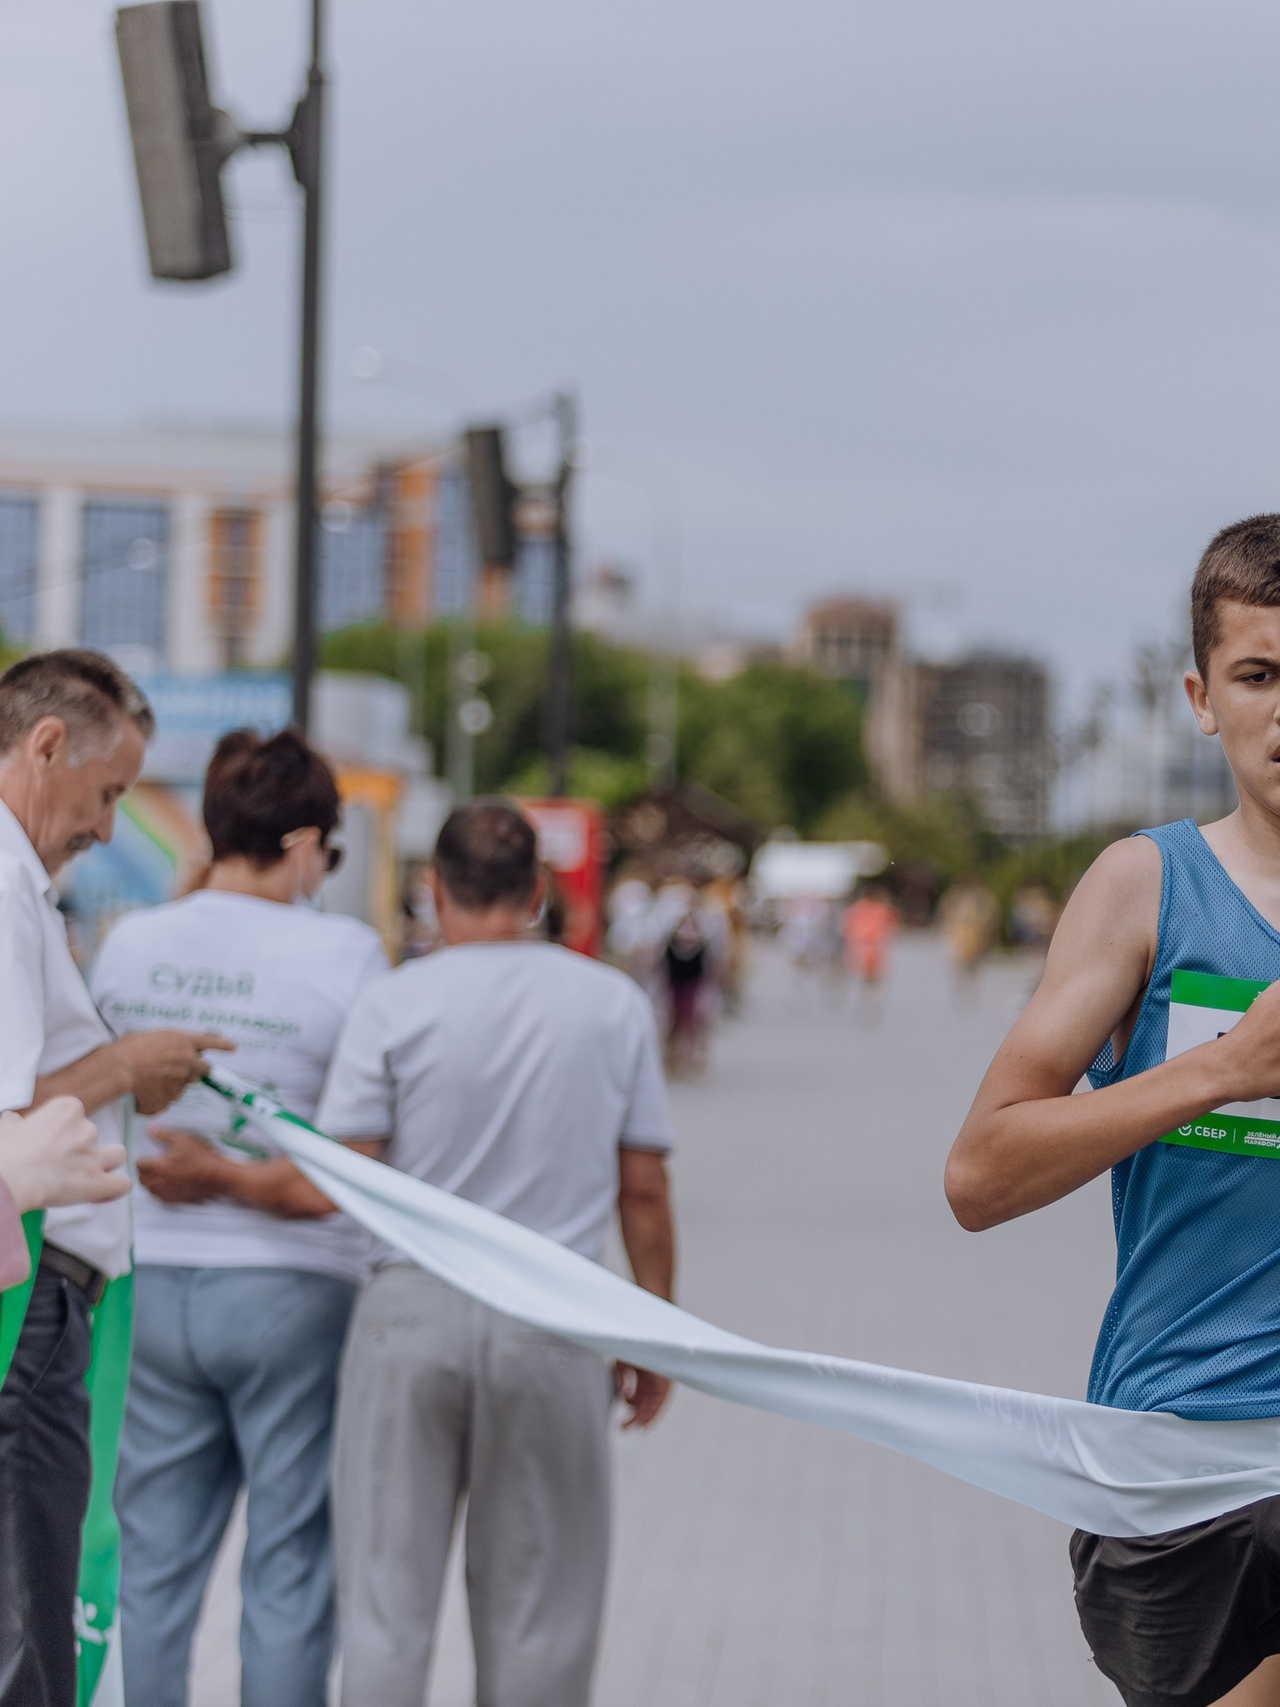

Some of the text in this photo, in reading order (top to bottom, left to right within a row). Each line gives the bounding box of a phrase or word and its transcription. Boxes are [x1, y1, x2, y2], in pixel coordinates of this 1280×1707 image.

[149, 963, 255, 999] СУДЬЯ
[1194, 1126, 1227, 1139] СБЕР
[1246, 1131, 1277, 1139] ЗЕЛЁНЫЙ
[1244, 1139, 1276, 1148] МАРАФОН
